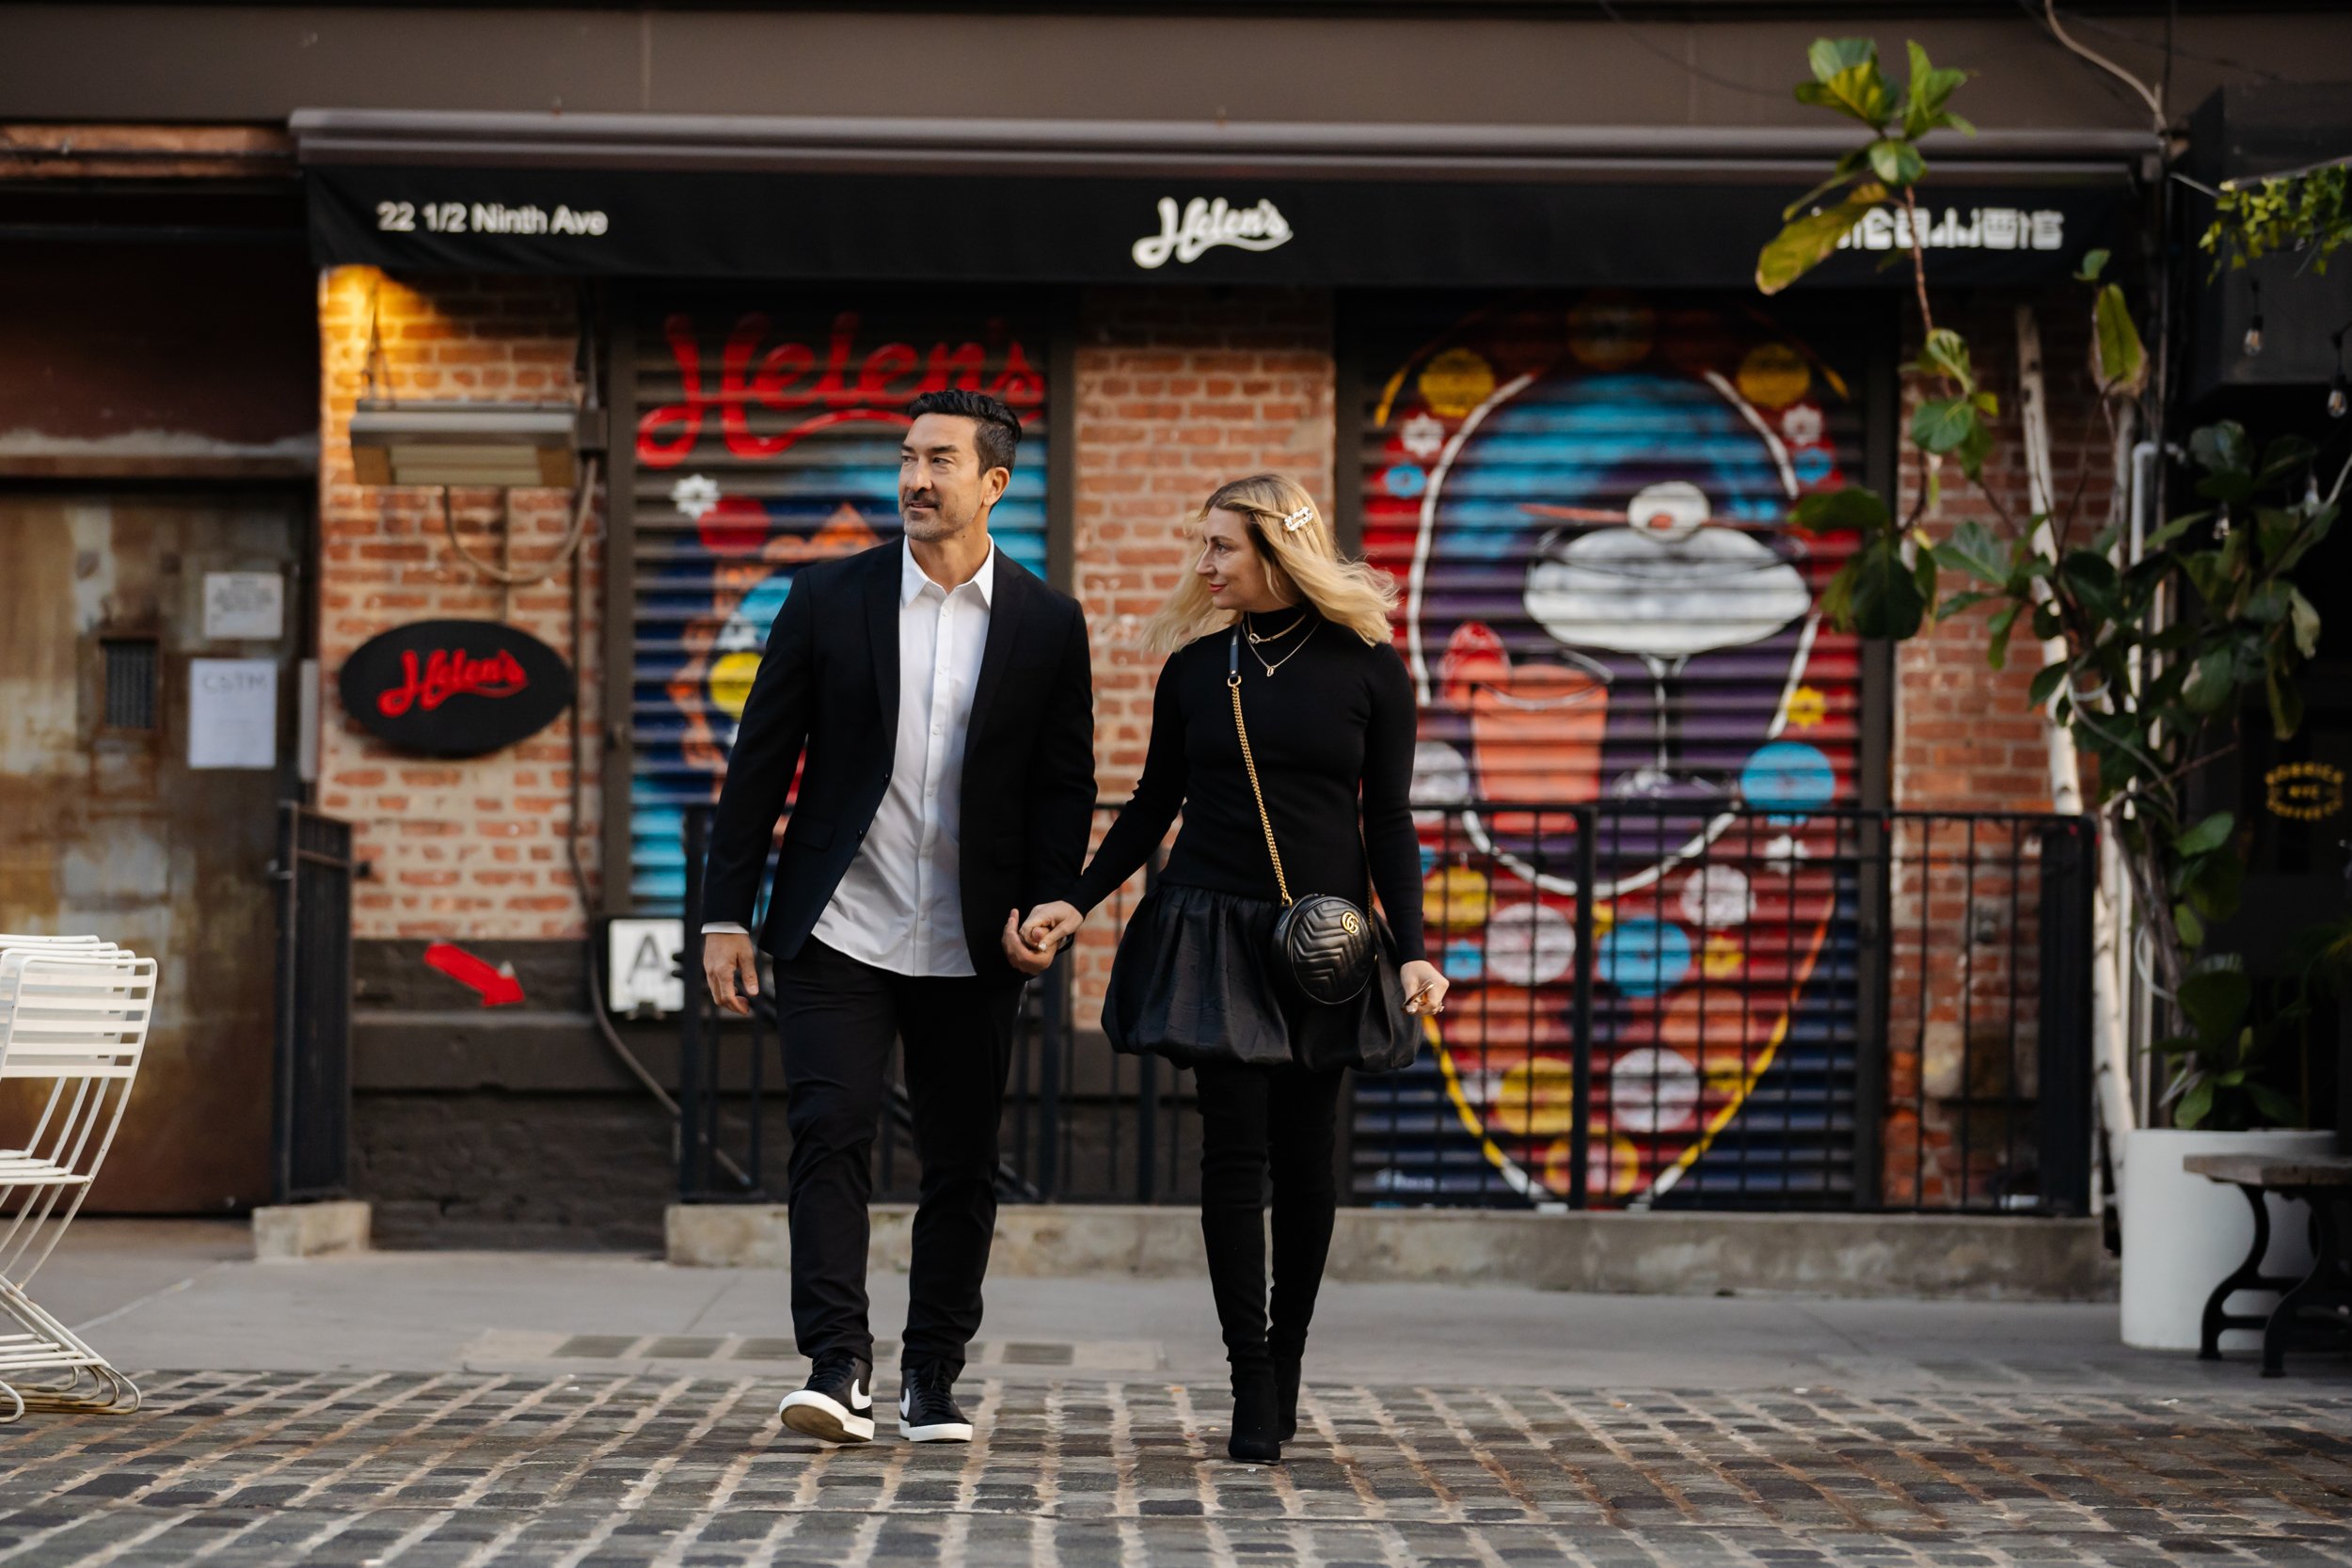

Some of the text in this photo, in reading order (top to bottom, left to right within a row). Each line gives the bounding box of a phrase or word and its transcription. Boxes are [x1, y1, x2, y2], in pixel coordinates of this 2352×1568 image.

[376, 200, 609, 235] 22 1/2 Ninth Ave
[1132, 197, 1294, 269] Helen's
[636, 312, 1045, 467] Helen's
[626, 933, 674, 986] A
